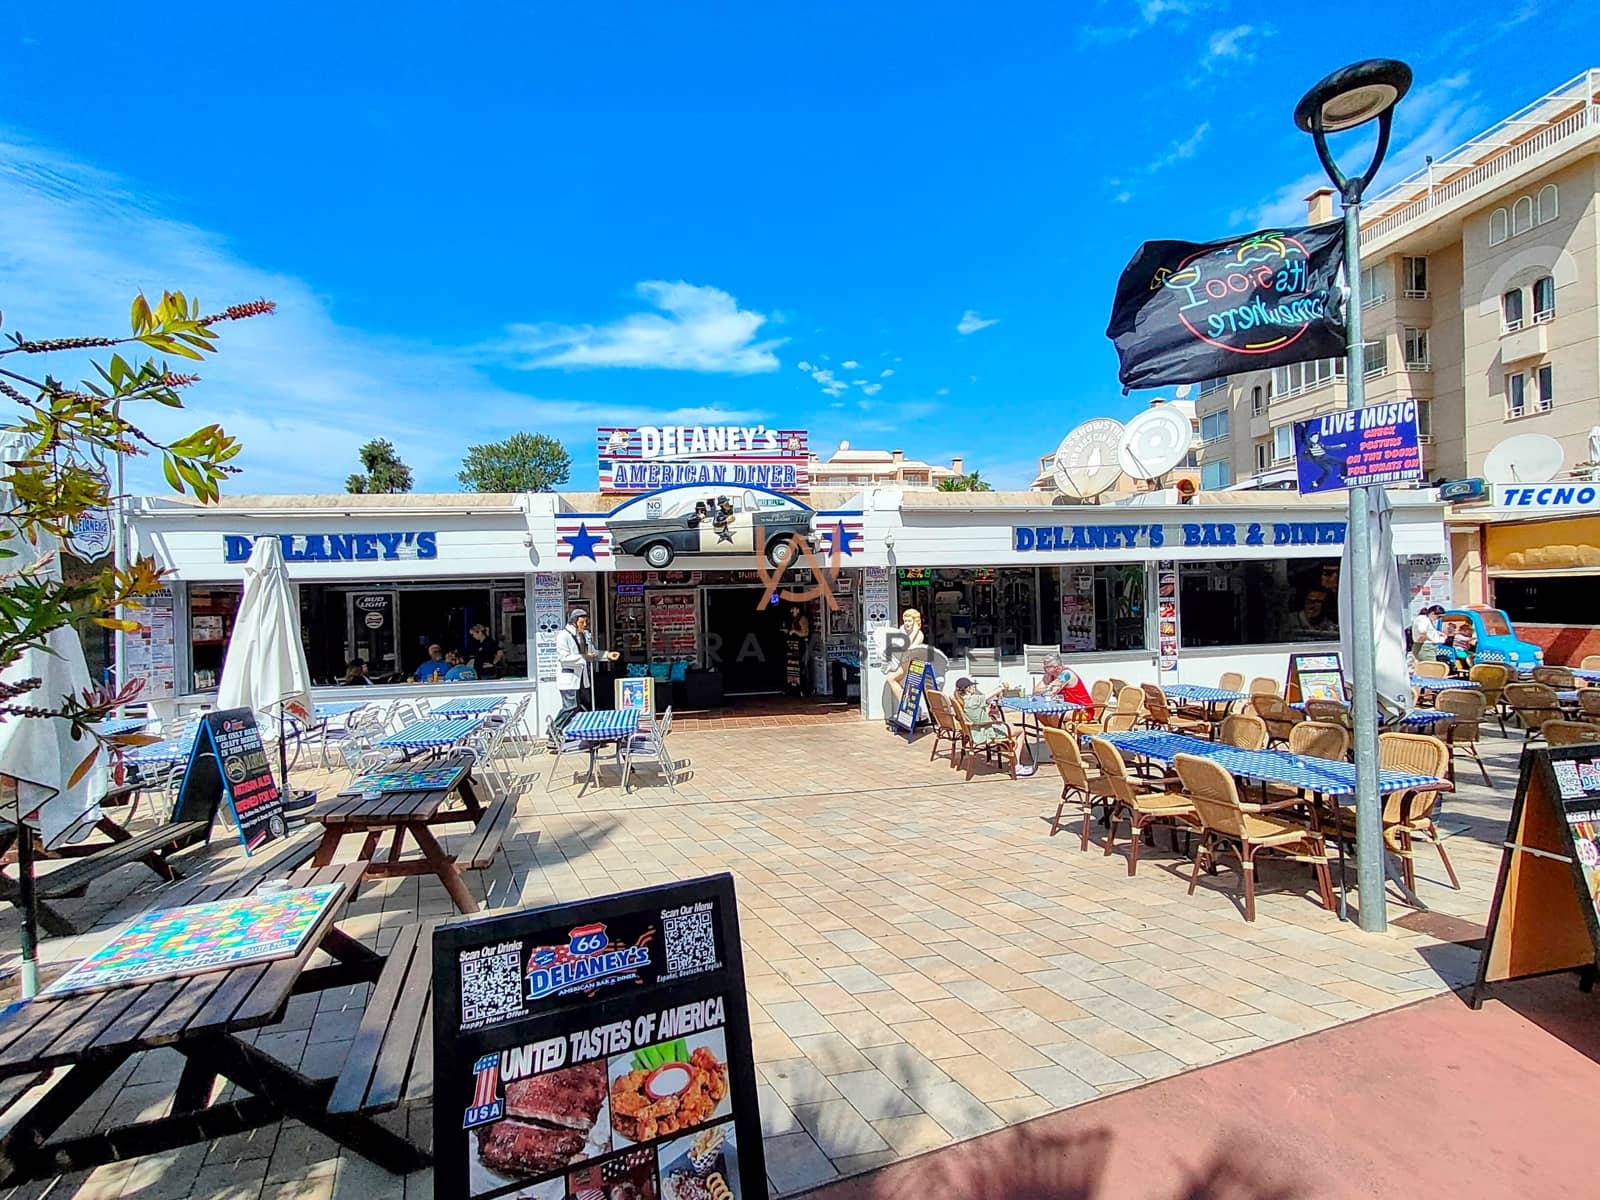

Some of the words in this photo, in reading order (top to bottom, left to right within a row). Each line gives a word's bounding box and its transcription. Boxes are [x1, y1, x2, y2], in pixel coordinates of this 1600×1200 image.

[1321, 410, 1355, 436] LIVE
[1360, 402, 1414, 429] MUSIC
[637, 425, 778, 458] DELANEY'S
[1364, 426, 1396, 439] CHECK
[1360, 437, 1403, 450] POSTERS
[1346, 455, 1361, 465] ON
[1363, 452, 1382, 462] THE
[1384, 447, 1418, 459] DOORS
[614, 464, 727, 488] AMERICAN
[734, 464, 797, 488] DINER
[1347, 466, 1366, 476] FOR
[1404, 459, 1419, 469] ON
[1358, 475, 1372, 485] BEST
[1373, 472, 1392, 483] SHOWS
[1393, 472, 1400, 481] IN
[1504, 488, 1596, 506] TECNO
[1016, 524, 1164, 551] DELANEY'S
[1183, 523, 1236, 546] BAR
[1246, 523, 1264, 545] &
[224, 532, 438, 562] DLANEY'S
[215, 734, 227, 743] THE
[228, 730, 243, 739] ONLY
[221, 739, 239, 749] CRAFT
[661, 909, 679, 920] Scan
[680, 905, 693, 915] Our
[694, 902, 713, 912] Menu
[459, 950, 480, 962] Scan
[481, 946, 496, 957] Our
[497, 940, 523, 954] Drinks
[577, 935, 601, 952] 66
[527, 946, 649, 996] DELANEY'S
[559, 983, 595, 997] AMERICAN
[596, 979, 611, 988] BAR
[617, 974, 637, 982] DINER
[460, 1019, 484, 1031] Happy
[486, 1014, 504, 1024] Hour
[506, 1008, 529, 1019] Offers
[501, 1036, 567, 1082] UNITED
[570, 1027, 631, 1063] TASTES
[634, 1014, 656, 1046] OF
[657, 996, 725, 1041] AMERICA
[467, 1105, 500, 1123] USA
